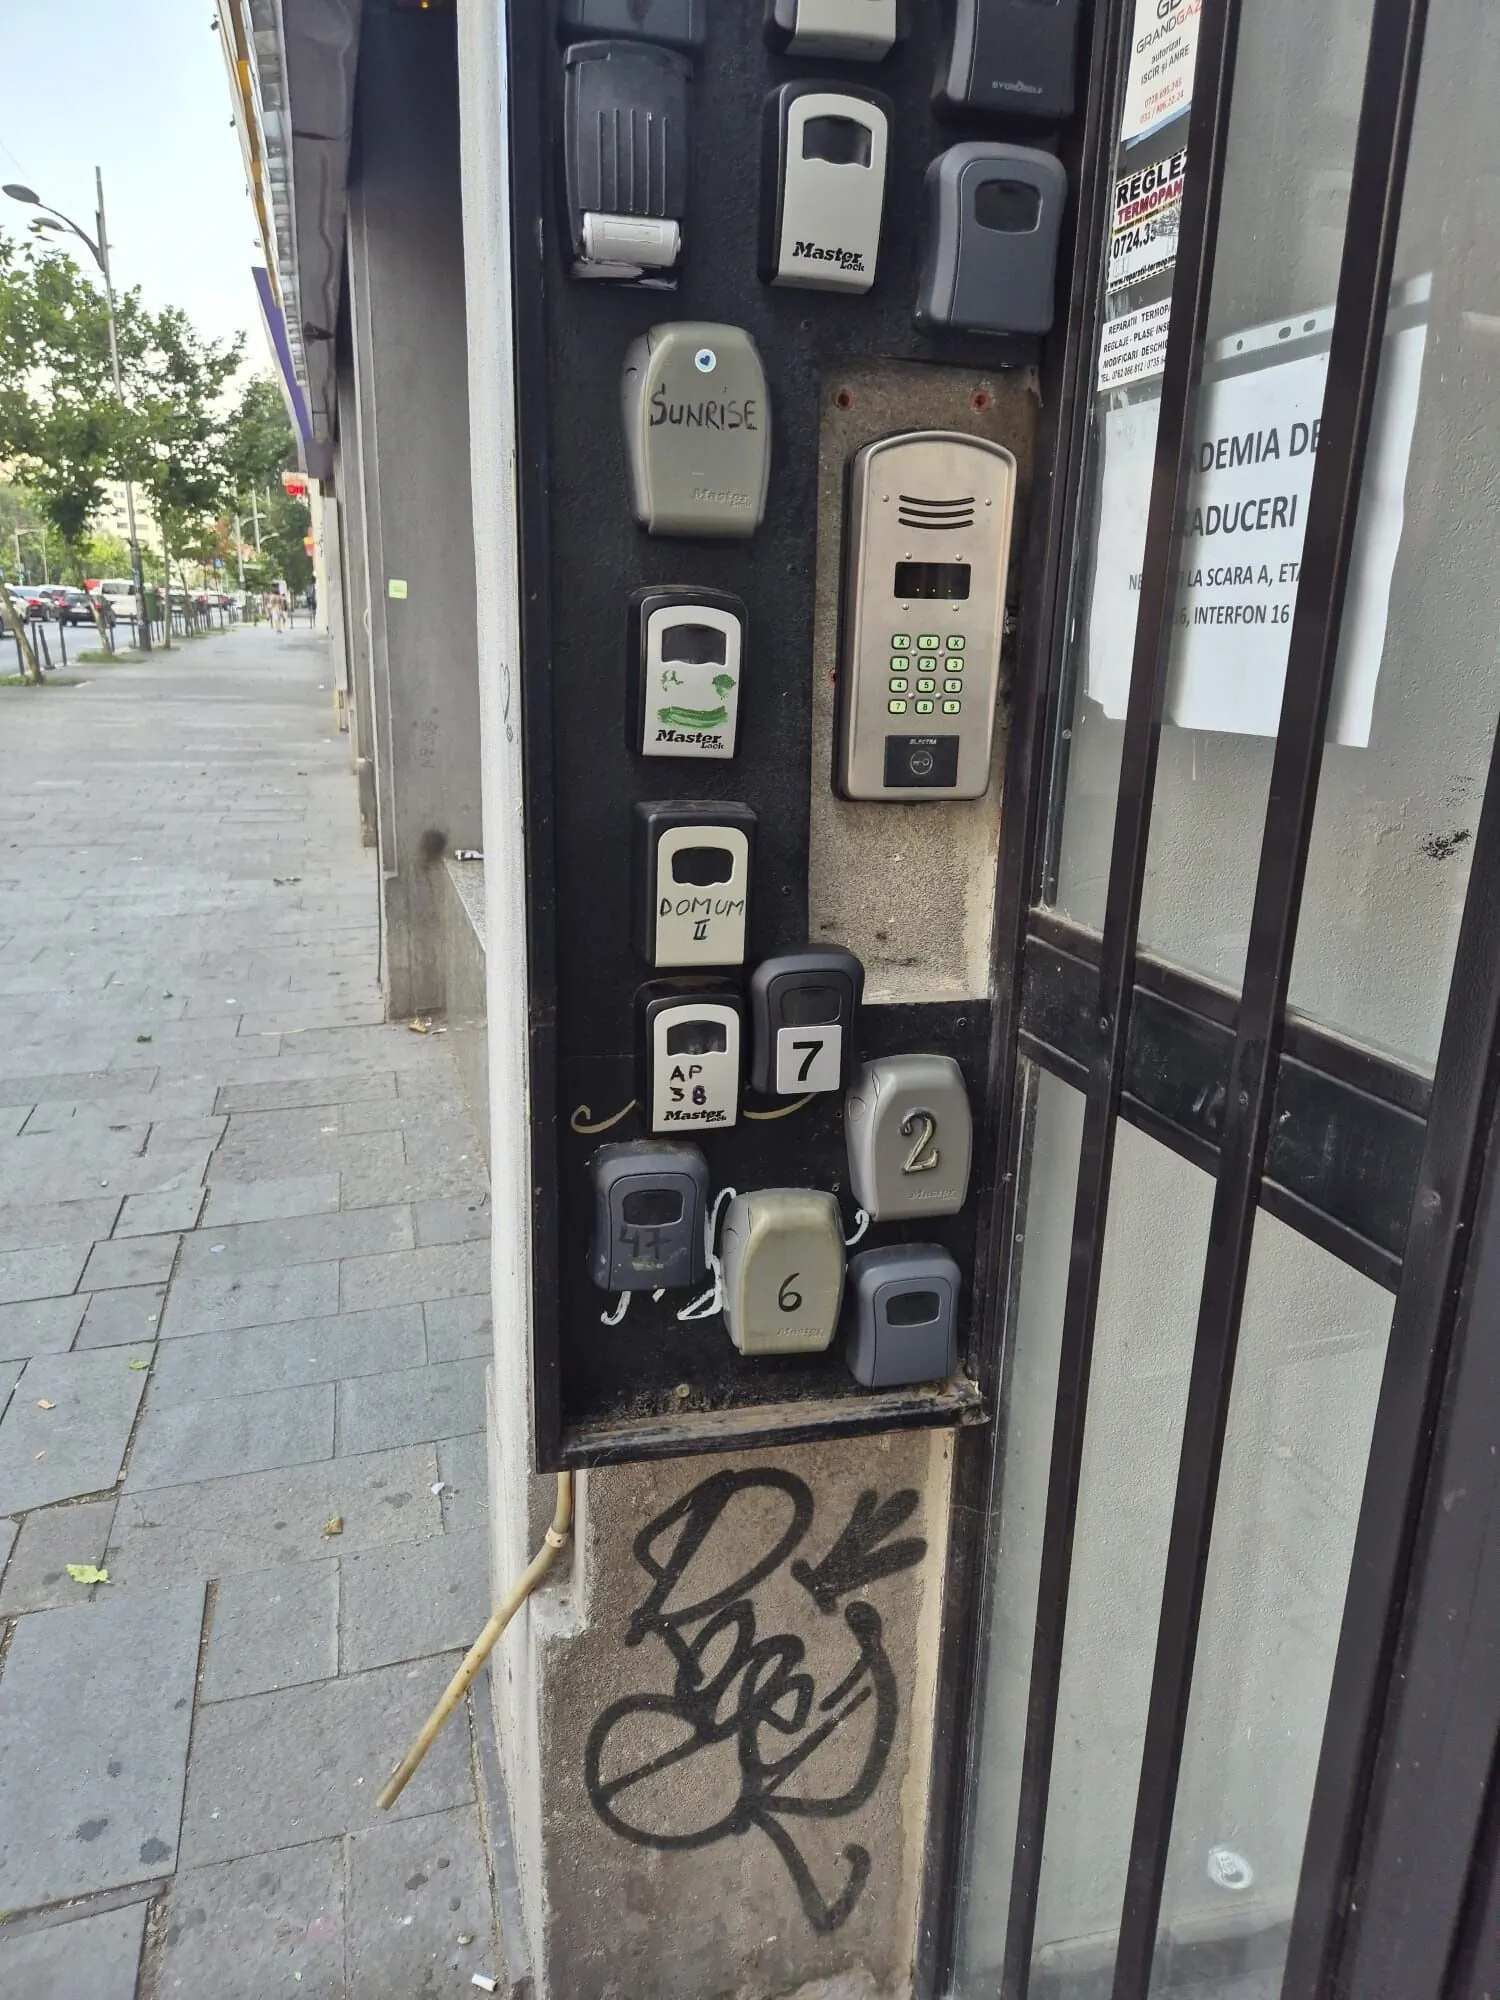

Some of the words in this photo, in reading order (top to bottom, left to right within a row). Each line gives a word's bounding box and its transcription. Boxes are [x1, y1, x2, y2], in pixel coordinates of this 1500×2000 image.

[1151, 36, 1181, 65] autorizat
[1141, 65, 1160, 86] ISCIR
[1168, 43, 1190, 67] ANRE
[1116, 154, 1186, 208] REGLE
[792, 241, 863, 263] Master
[840, 261, 865, 271] Lock
[1142, 304, 1170, 322] TERMOP
[650, 383, 758, 430] SUNRISE
[1187, 570, 1202, 587] LA
[1206, 565, 1253, 586] SCARA
[1257, 564, 1273, 587] A,
[1194, 604, 1267, 624] INTERFON
[1271, 604, 1290, 624] 16
[656, 730, 722, 743] Master
[701, 741, 724, 750] Lock
[660, 897, 744, 916] DOMUM
[793, 1040, 823, 1081] 7
[670, 1065, 703, 1083] AP
[664, 1109, 725, 1122] Master
[902, 1108, 938, 1173] 2
[778, 1273, 802, 1313] 6
